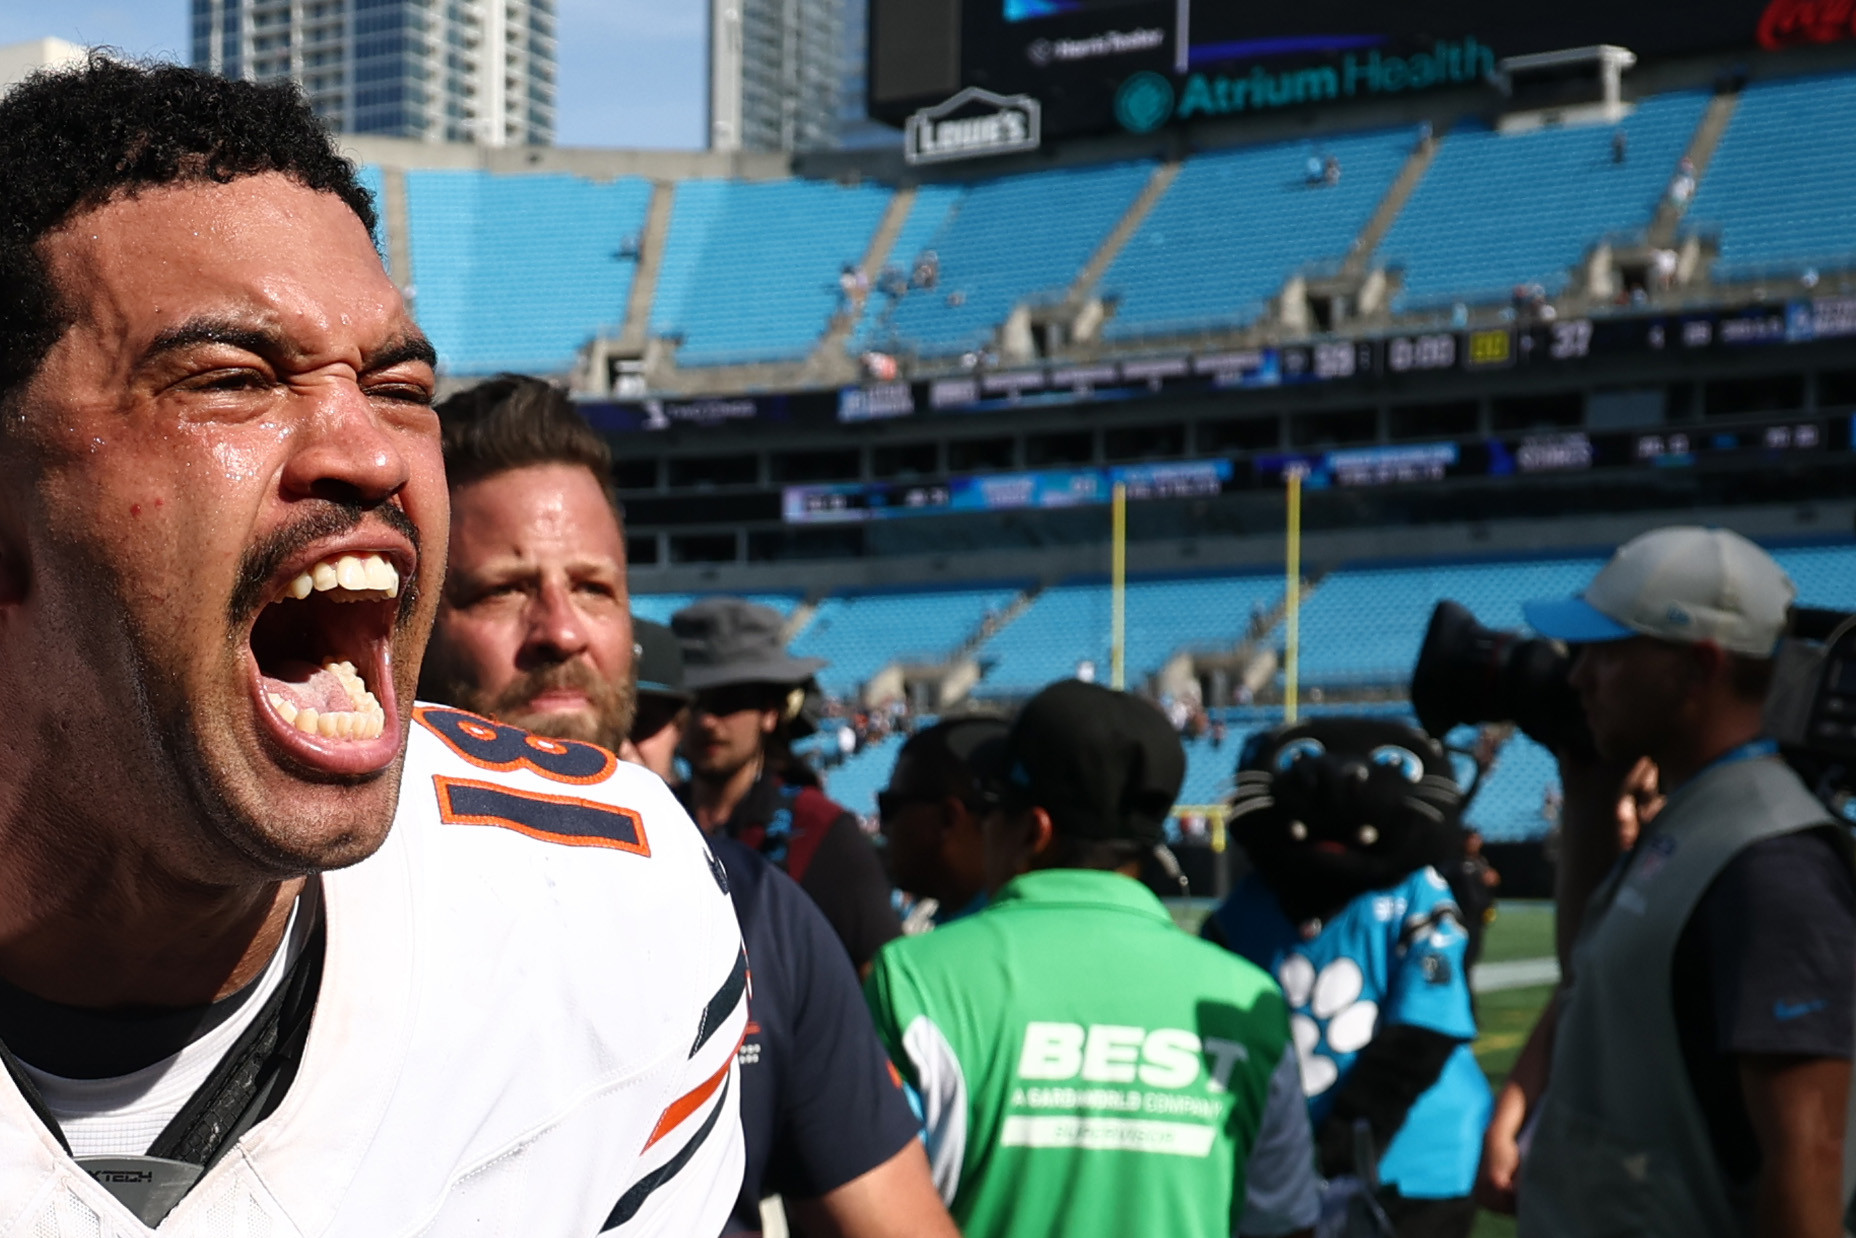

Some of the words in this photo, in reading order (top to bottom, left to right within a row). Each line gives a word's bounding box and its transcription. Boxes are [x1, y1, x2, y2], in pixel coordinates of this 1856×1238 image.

[1178, 65, 1339, 118] Atrium
[1343, 34, 1495, 96] Health
[411, 705, 652, 858] 18
[1016, 1020, 1249, 1094] BEST
[1143, 1091, 1223, 1120] COMPANY
